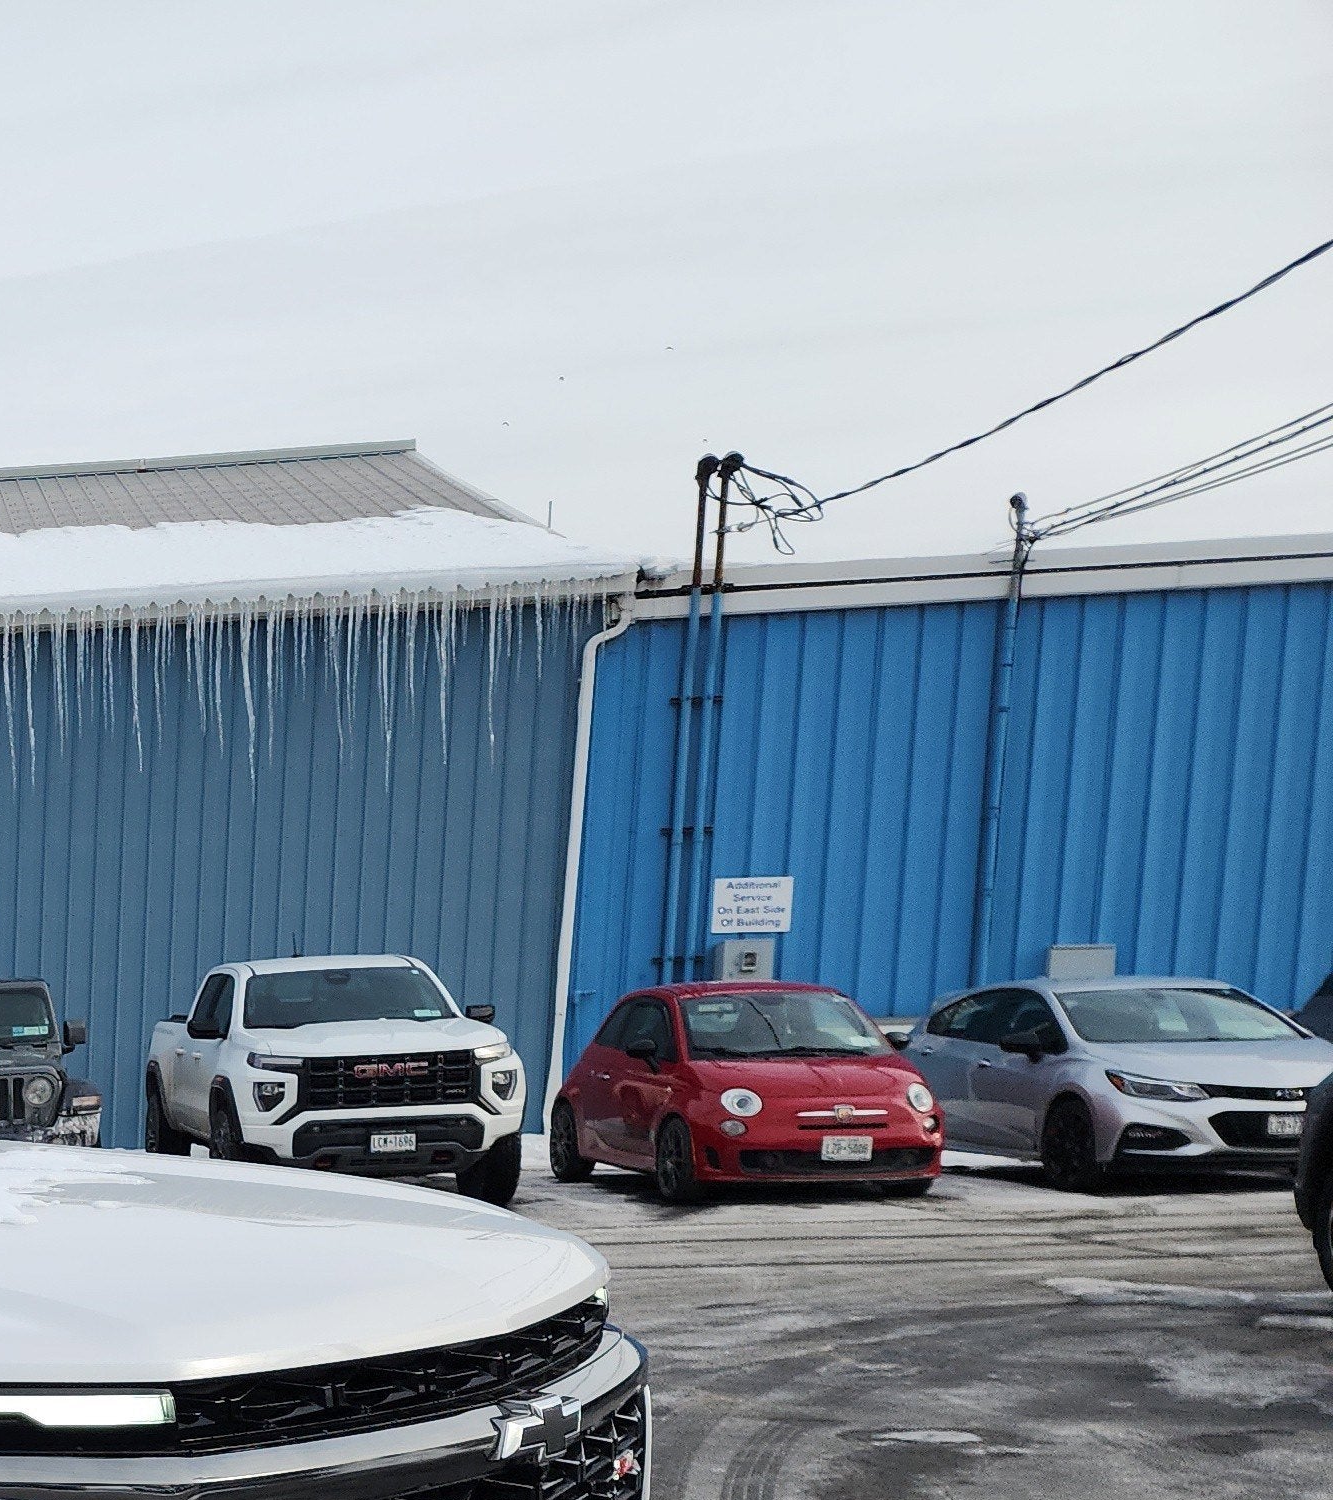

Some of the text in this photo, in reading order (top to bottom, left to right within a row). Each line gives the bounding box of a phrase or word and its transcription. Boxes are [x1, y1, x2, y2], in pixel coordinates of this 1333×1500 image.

[726, 881, 781, 889] Additional
[733, 894, 772, 902] Service
[717, 905, 786, 914] On East Side
[721, 918, 781, 928] Of Building
[353, 1060, 429, 1079] GMC
